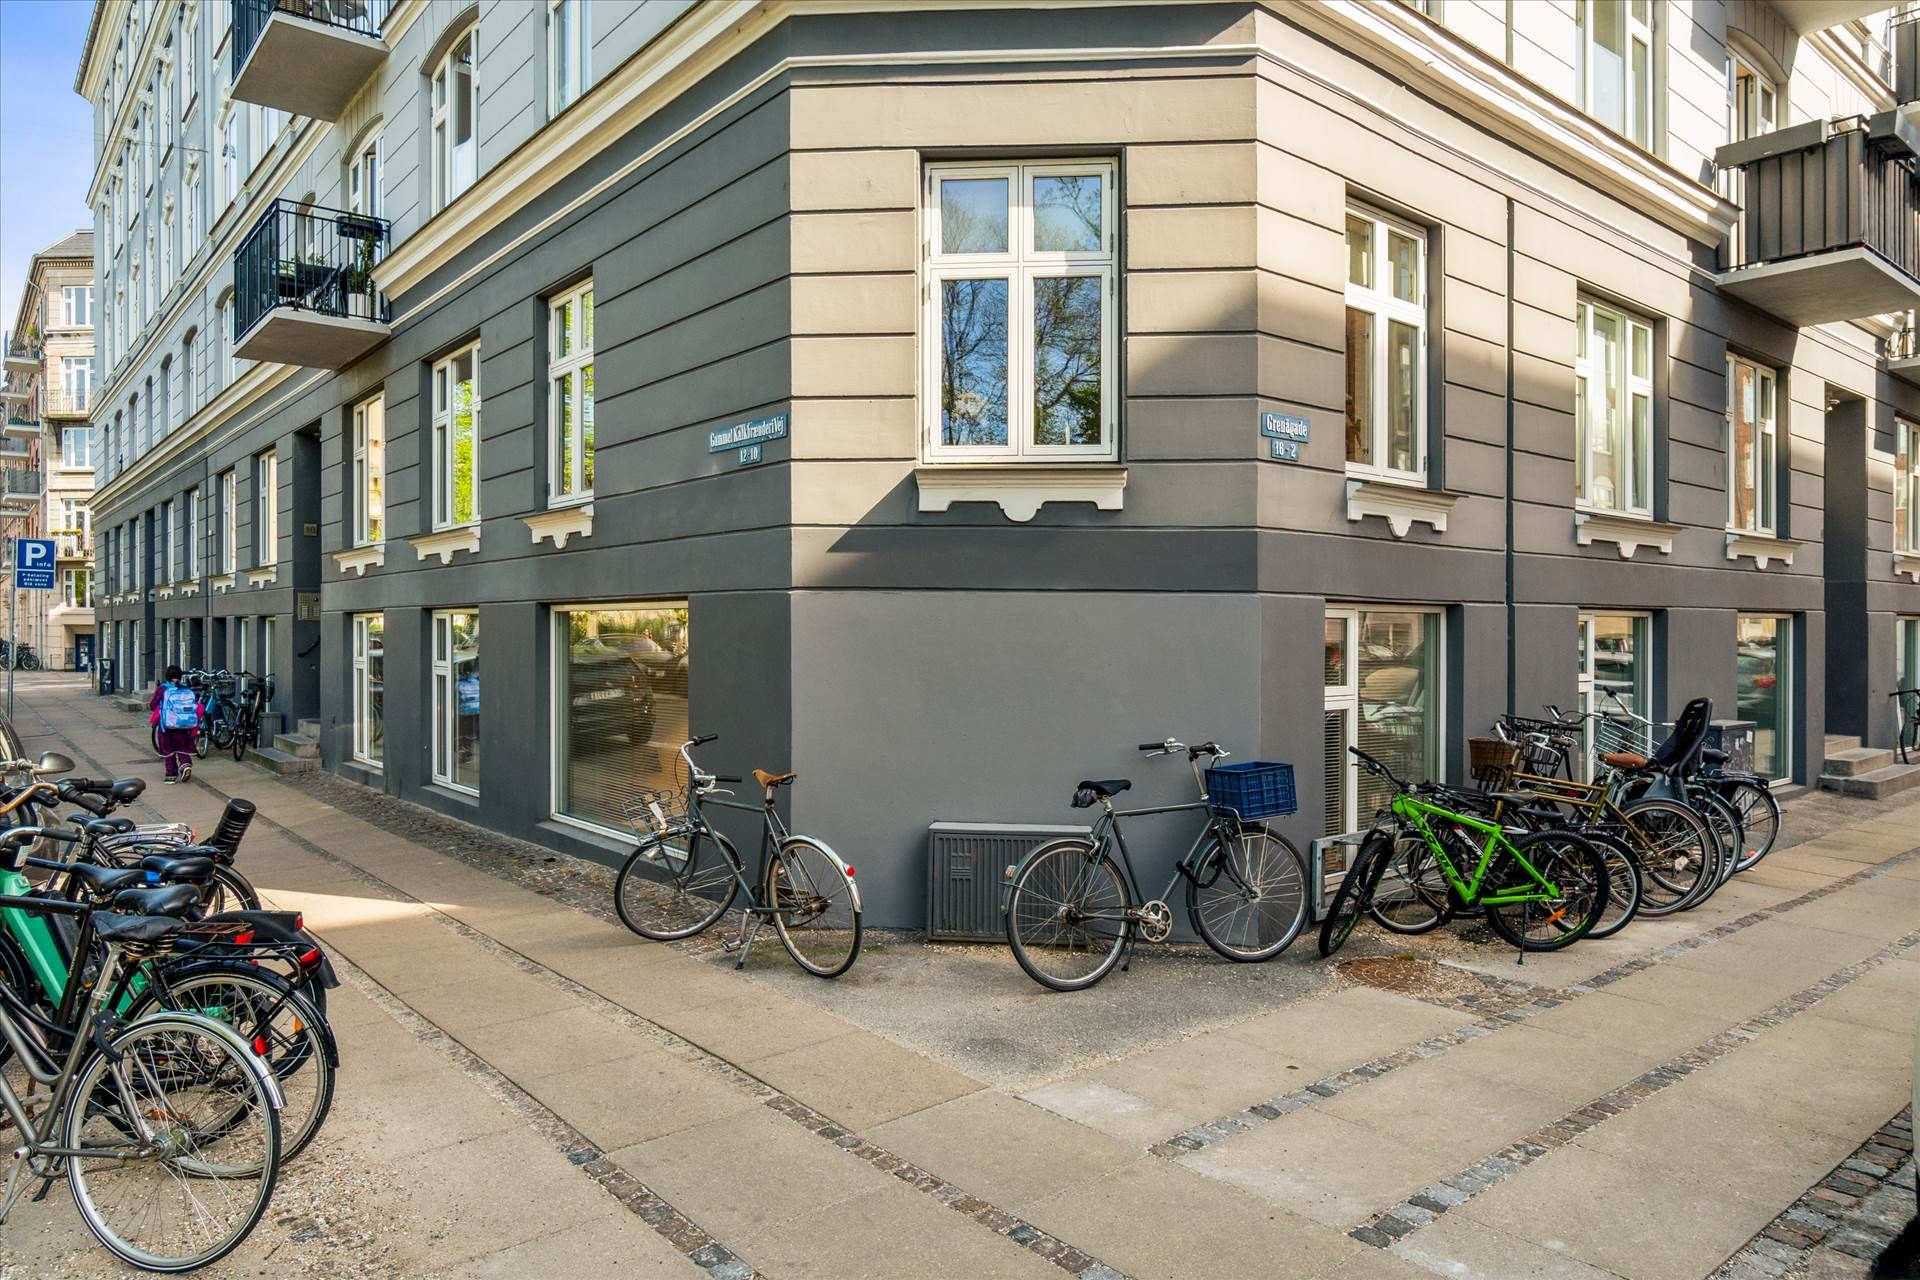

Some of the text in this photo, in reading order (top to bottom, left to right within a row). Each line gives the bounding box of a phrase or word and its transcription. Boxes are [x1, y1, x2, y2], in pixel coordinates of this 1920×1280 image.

[710, 428, 733, 447] Gammel
[1266, 414, 1308, 438] Grenågade
[26, 543, 47, 566] P
